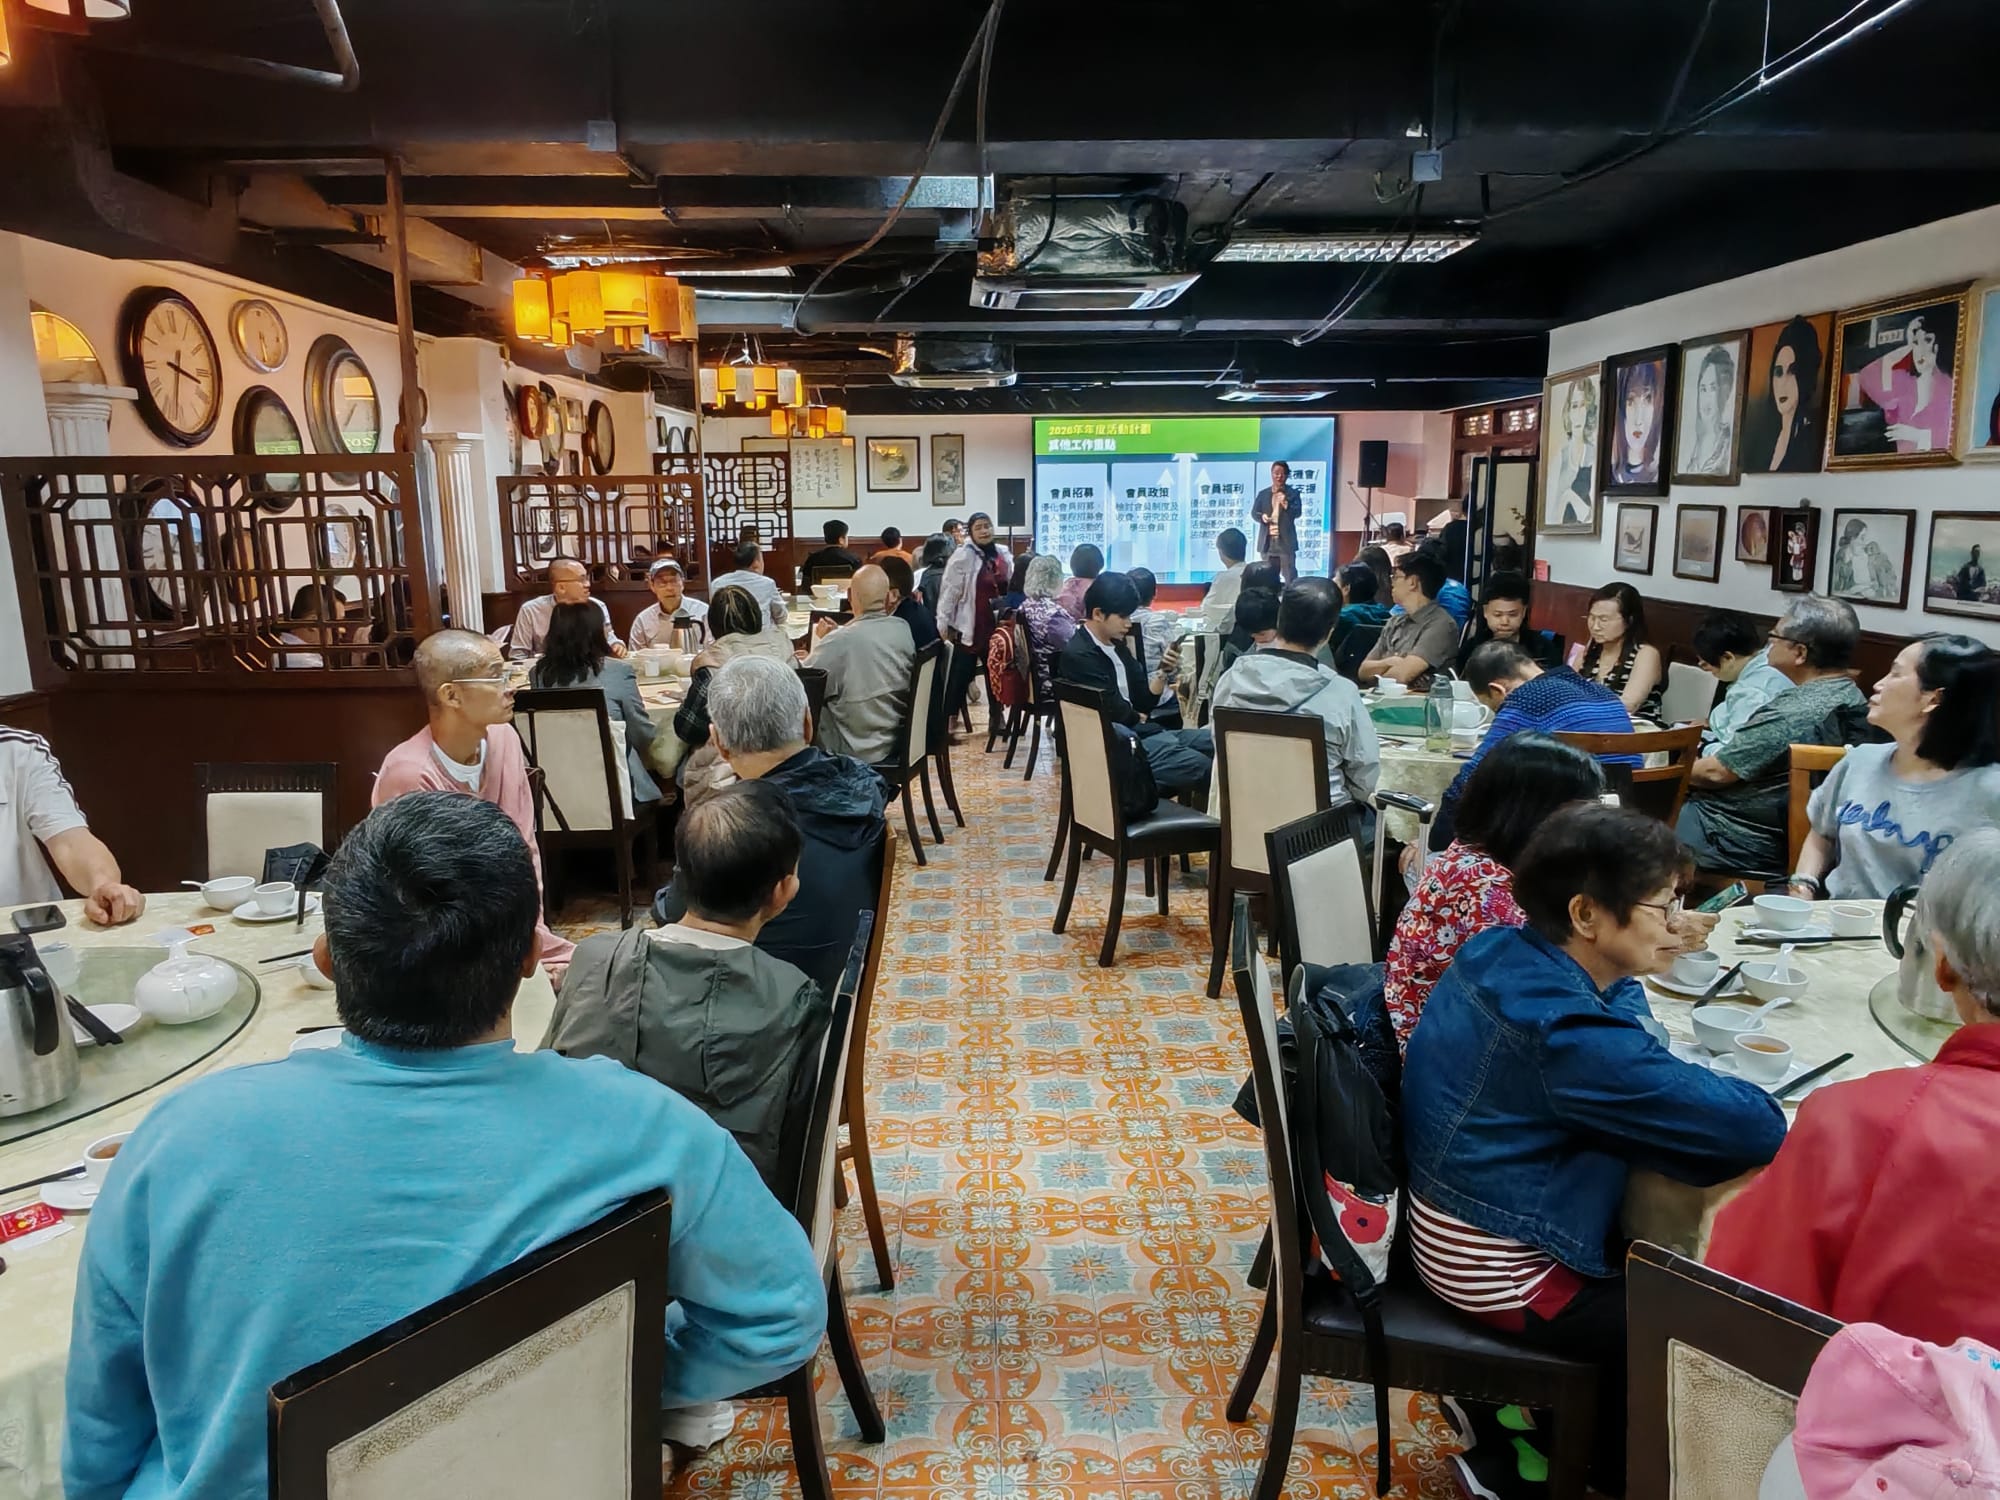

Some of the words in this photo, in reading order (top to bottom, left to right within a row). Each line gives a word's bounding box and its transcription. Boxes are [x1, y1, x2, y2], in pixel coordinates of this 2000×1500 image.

[1050, 487, 1094, 499] 會員招募
[1126, 487, 1169, 498] 會員政策
[1200, 483, 1244, 494] 會員福利
